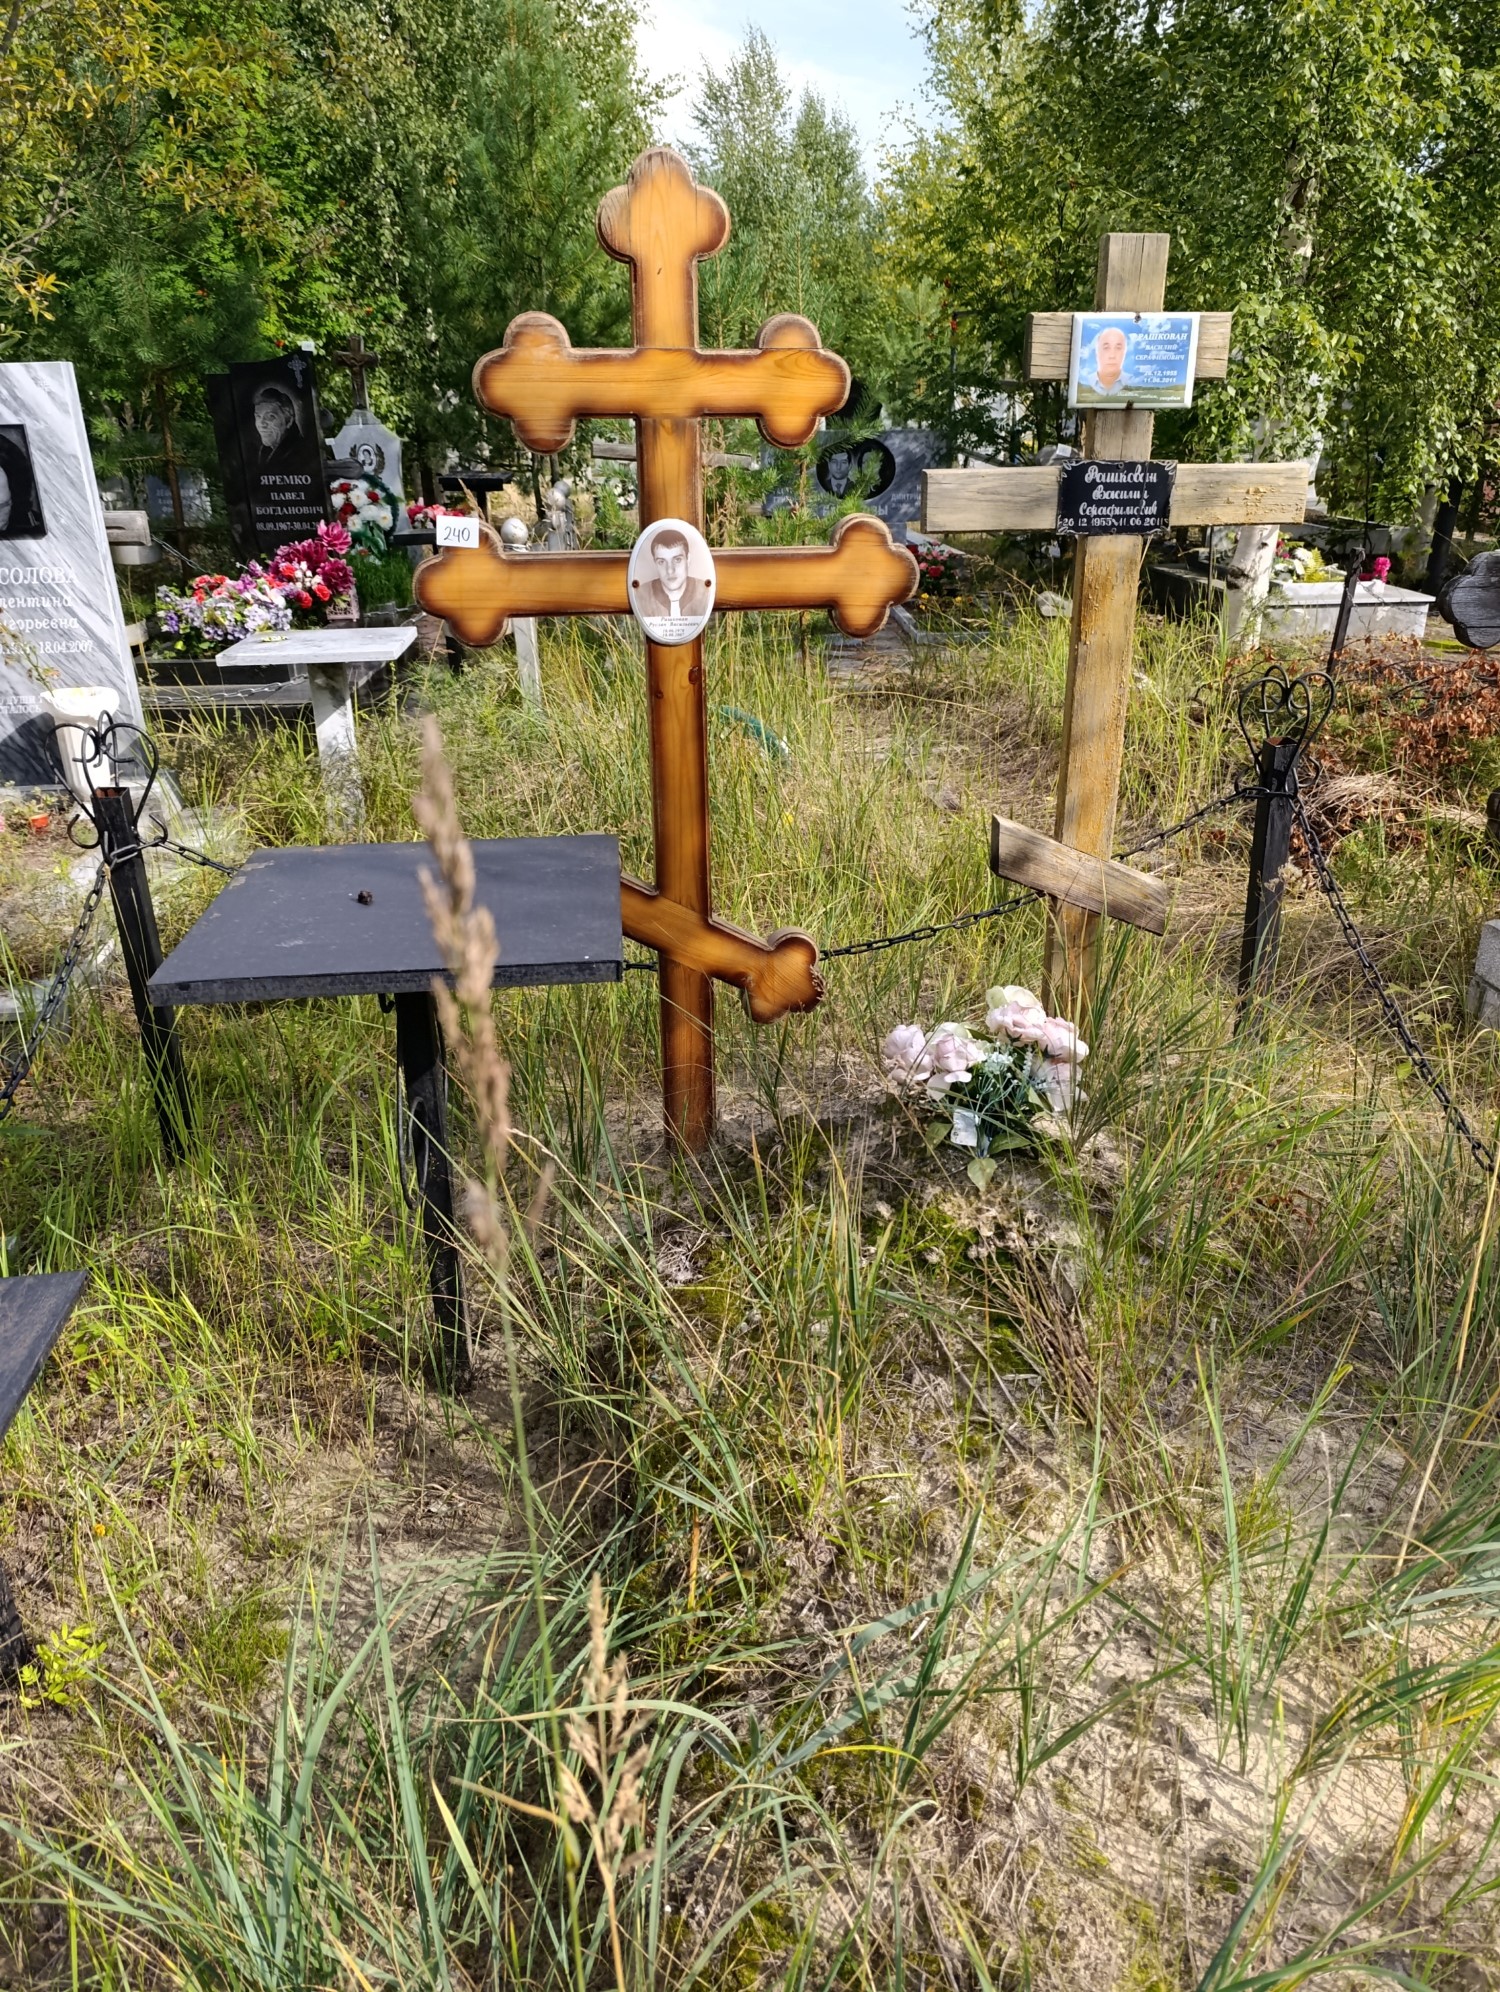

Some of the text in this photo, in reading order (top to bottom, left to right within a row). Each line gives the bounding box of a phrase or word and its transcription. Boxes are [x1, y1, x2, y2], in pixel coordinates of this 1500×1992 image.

[260, 474, 312, 486] ЯРЕМКО
[270, 491, 306, 501] ПАВЕЛ
[256, 506, 324, 516] БОГДАНОВИЧ
[256, 521, 319, 531] 08.09.1967-30.04.2
[443, 525, 471, 543] 240
